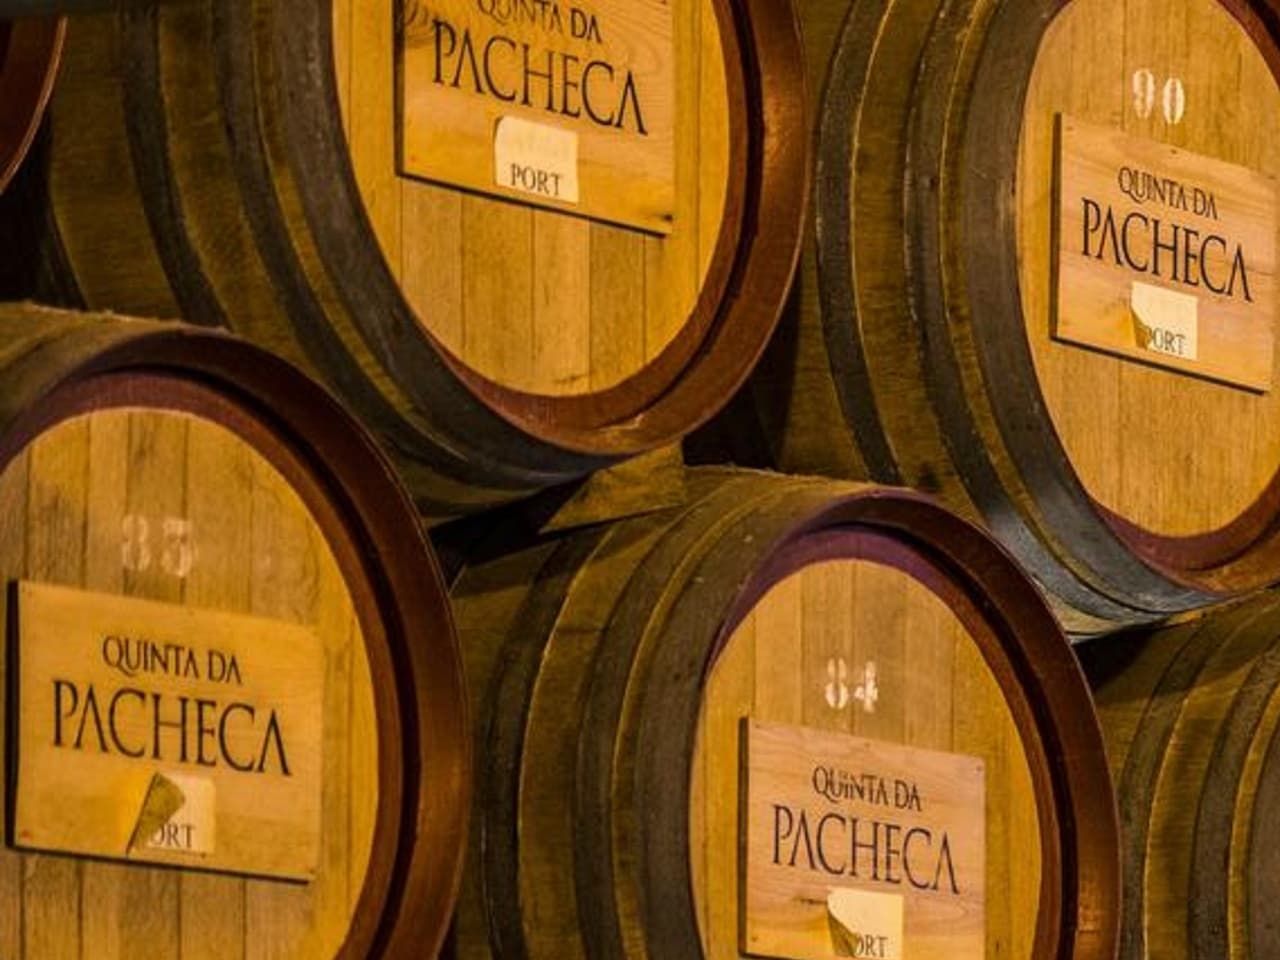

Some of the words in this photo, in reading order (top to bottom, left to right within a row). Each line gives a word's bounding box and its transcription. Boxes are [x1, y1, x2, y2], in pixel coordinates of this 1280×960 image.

[571, 7, 603, 45] DA
[431, 18, 649, 137] PACHECA
[510, 162, 563, 197] PORT
[1117, 166, 1188, 213] QUINTA
[1193, 186, 1219, 221] DA
[1080, 197, 1254, 304] PACHECA
[102, 634, 200, 683] QUINTA
[207, 648, 244, 686] DA
[51, 678, 292, 777] PACHECA
[810, 765, 890, 807] QUINTA
[894, 779, 922, 813] DA
[771, 803, 961, 895] PACHECA
